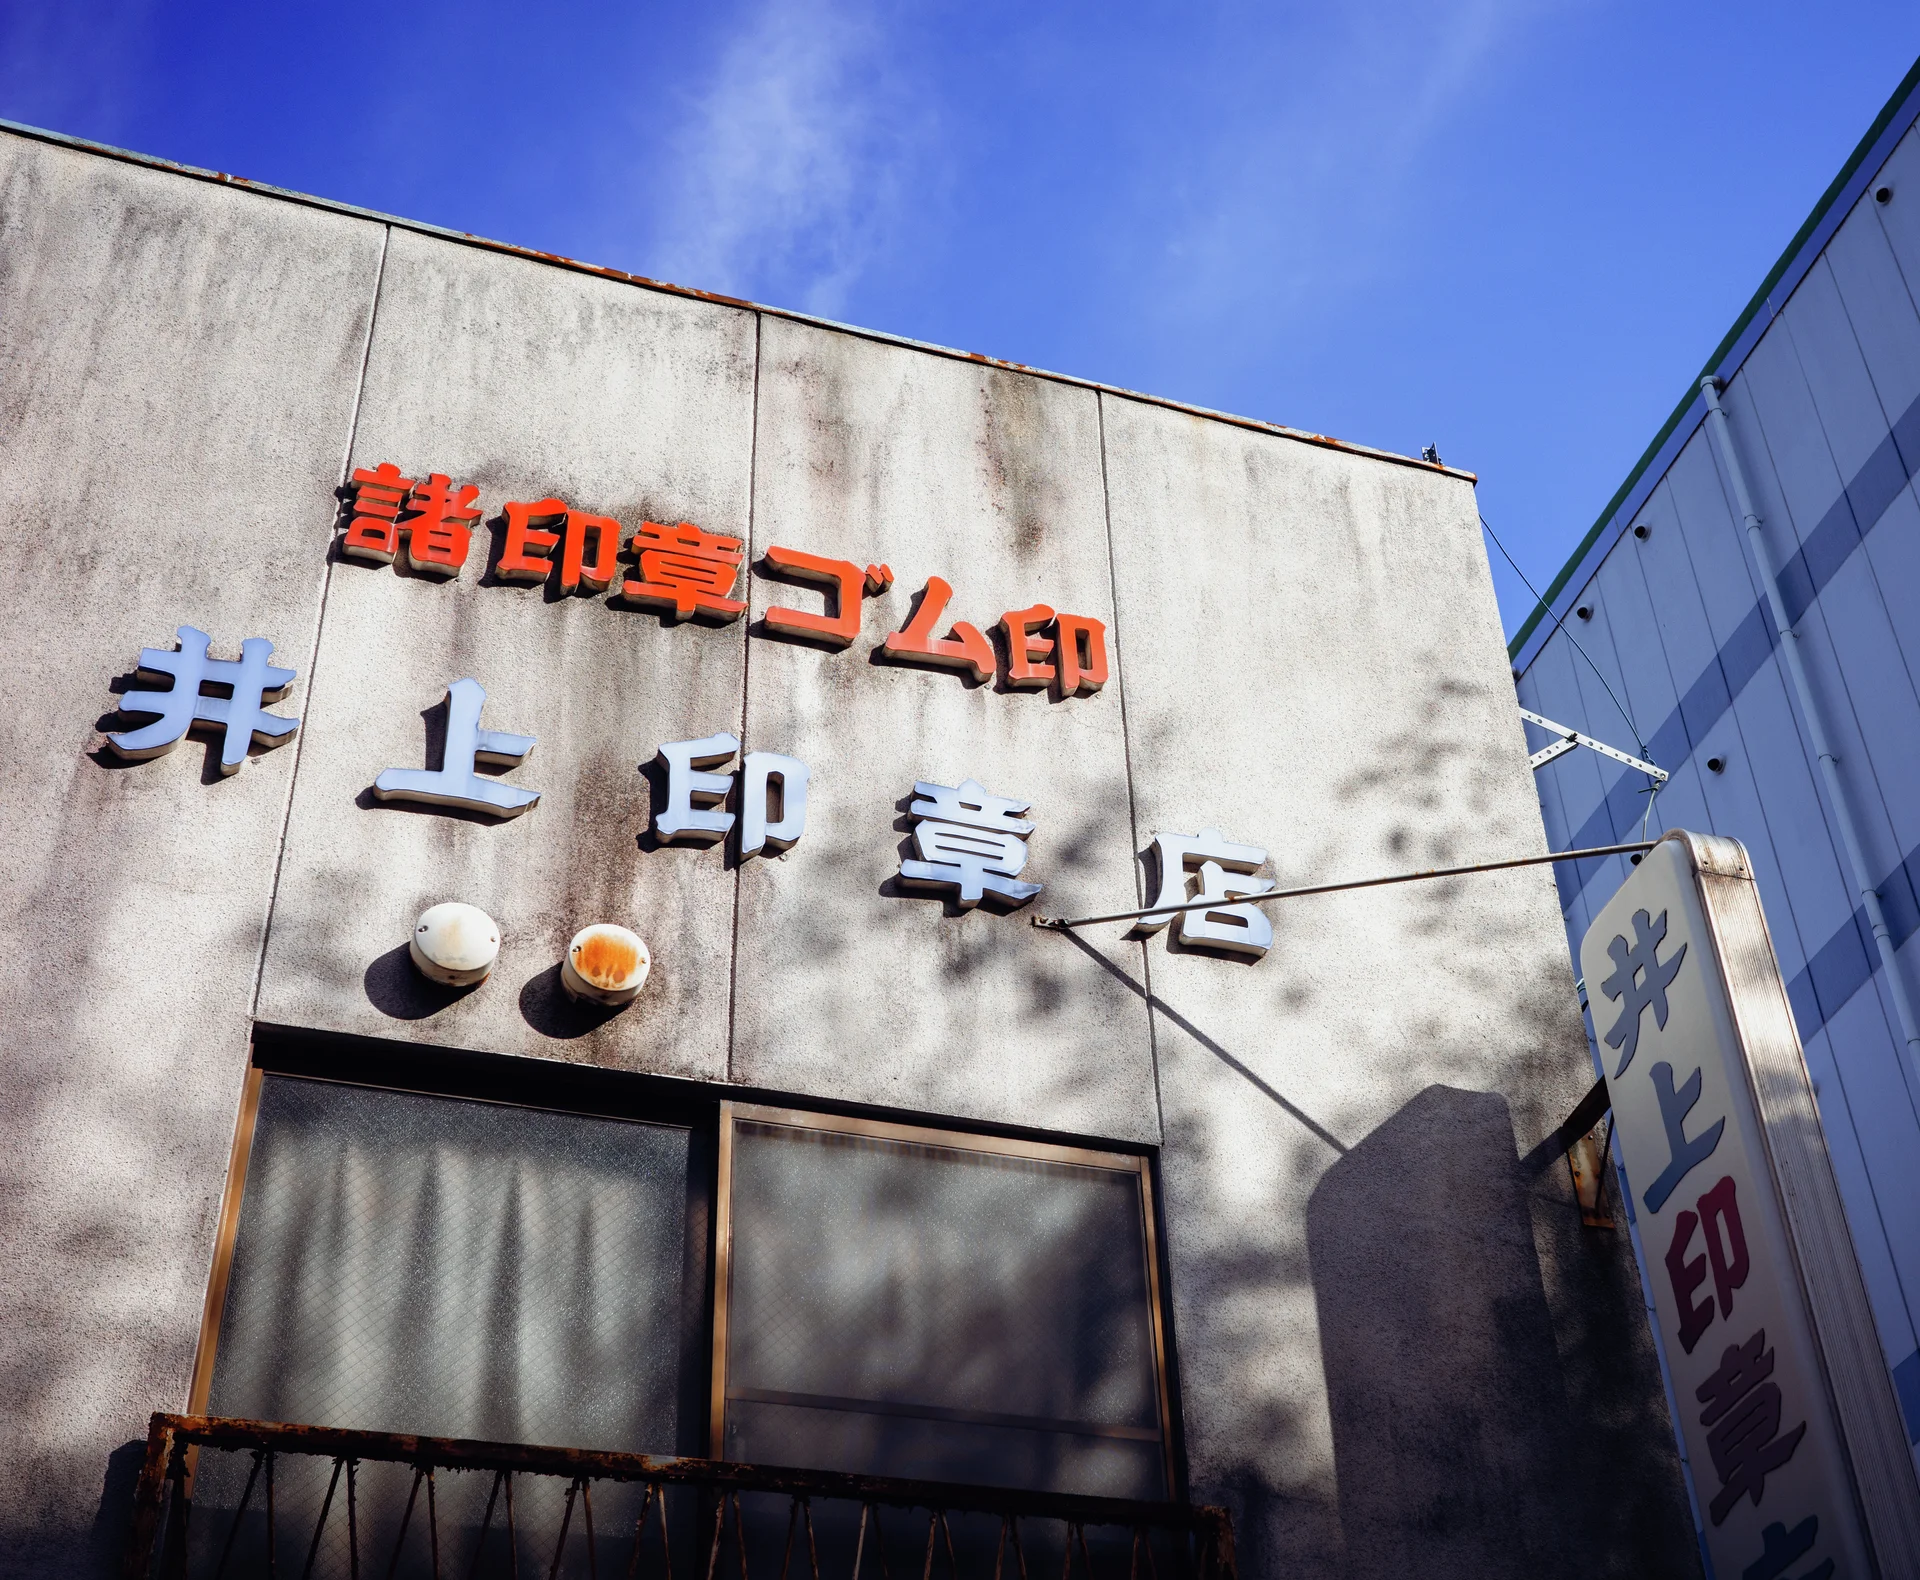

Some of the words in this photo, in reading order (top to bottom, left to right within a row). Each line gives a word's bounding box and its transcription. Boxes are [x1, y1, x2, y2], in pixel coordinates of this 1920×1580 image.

[342, 463, 1107, 697] 諸印章ゴム印
[107, 625, 1276, 958] 井上印章店
